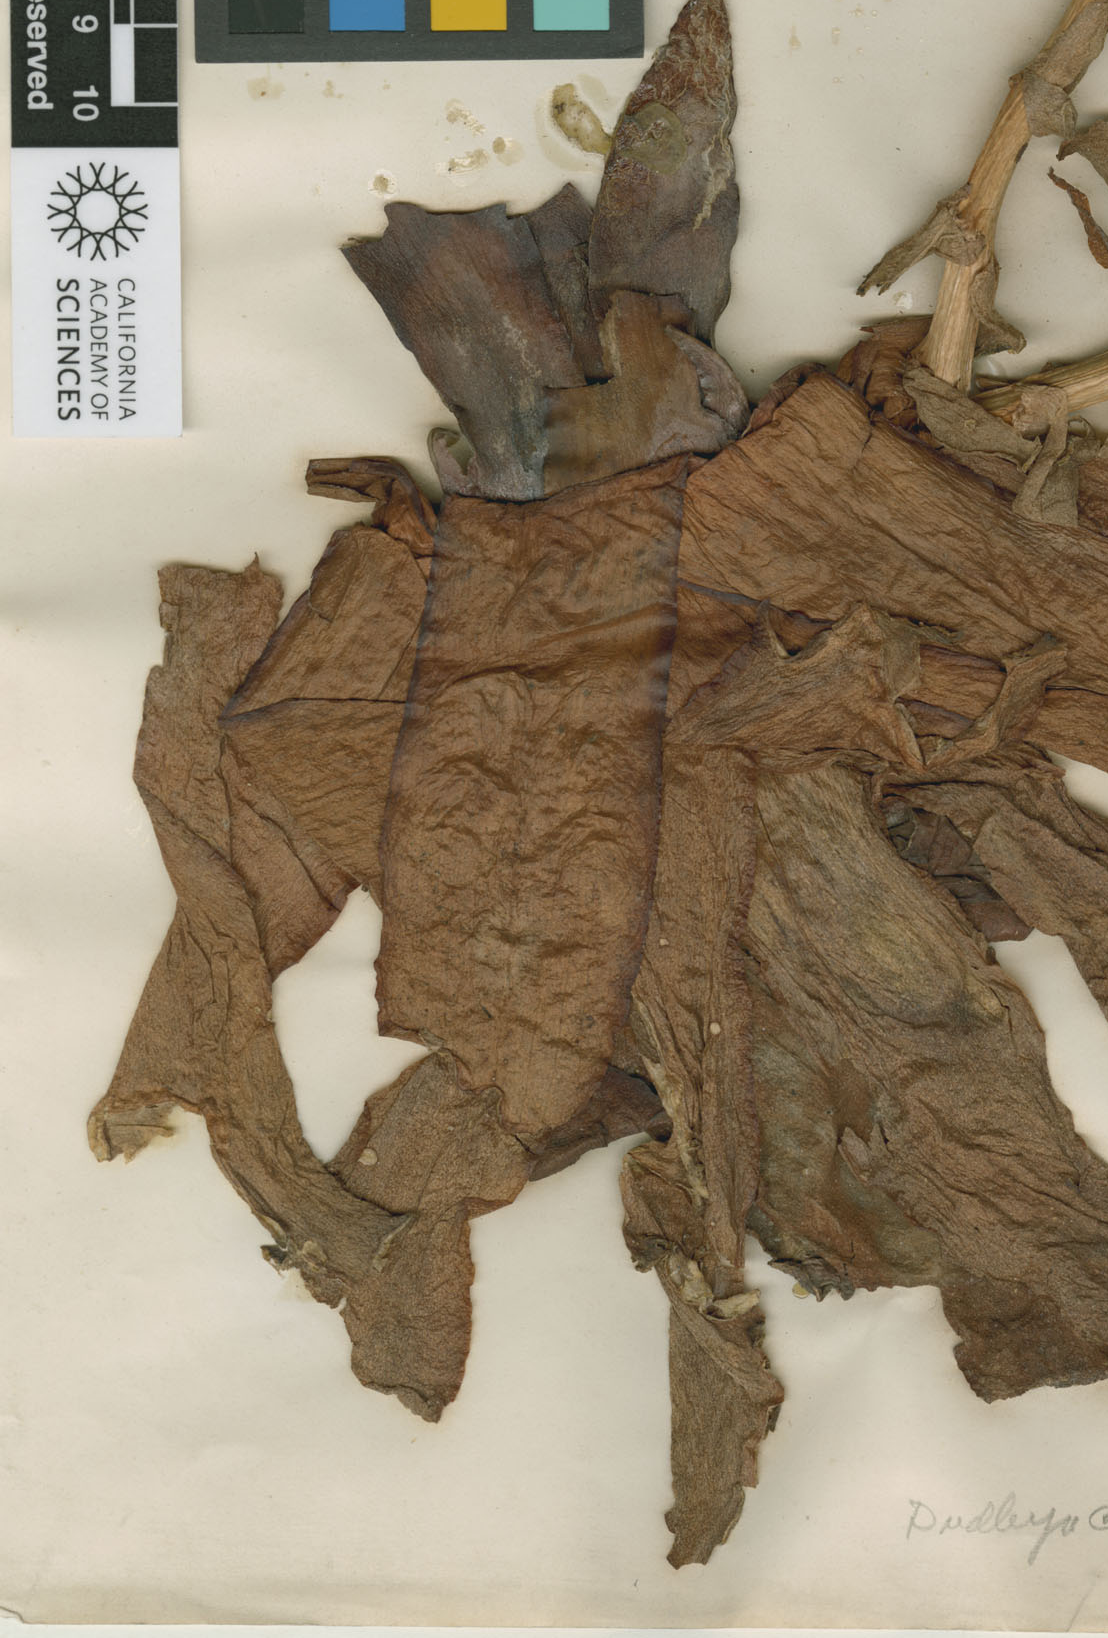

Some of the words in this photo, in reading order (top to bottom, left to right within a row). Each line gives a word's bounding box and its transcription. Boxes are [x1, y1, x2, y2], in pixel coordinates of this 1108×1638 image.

[71, 14, 99, 34] 9
[72, 85, 100, 122] 10
[56, 278, 81, 421] SCIENCES
[89, 278, 109, 388] ACADEMY
[117, 278, 137, 421] CALIFORNIA
[90, 393, 109, 421] OF
